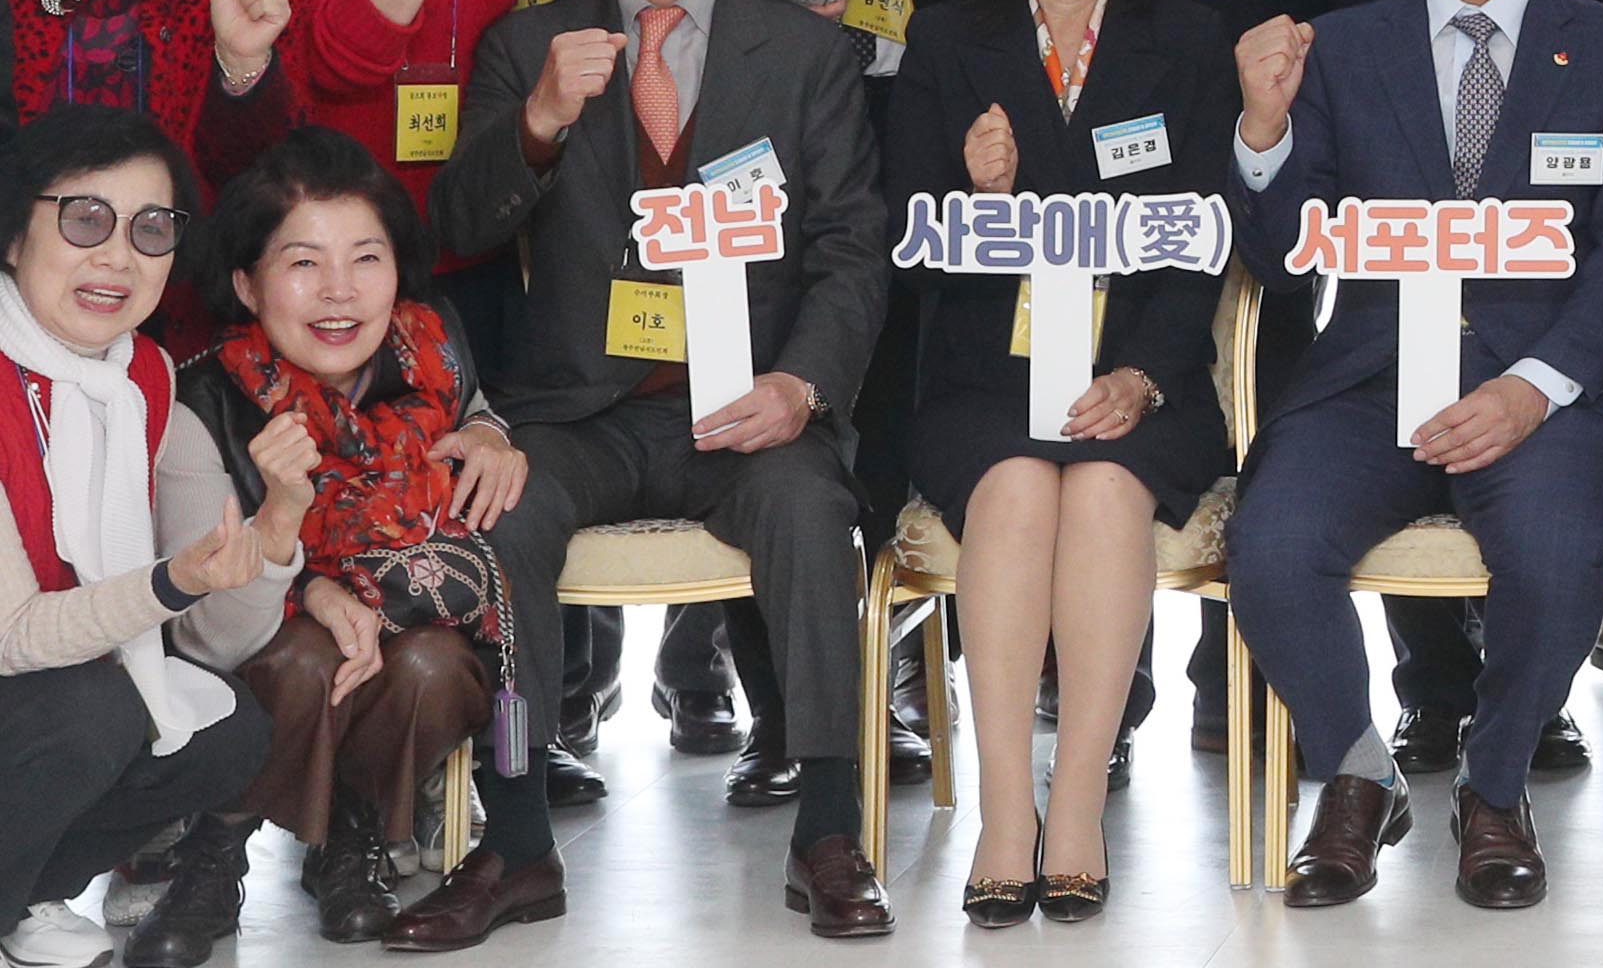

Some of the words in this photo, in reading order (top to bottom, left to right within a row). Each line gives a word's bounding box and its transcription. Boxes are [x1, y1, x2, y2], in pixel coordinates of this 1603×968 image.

[408, 113, 446, 132] 최선희
[638, 184, 783, 265] 전남
[898, 194, 1223, 269] 사랑애(愛)
[1292, 204, 1569, 273] 서포터즈
[632, 311, 666, 330] 이호
